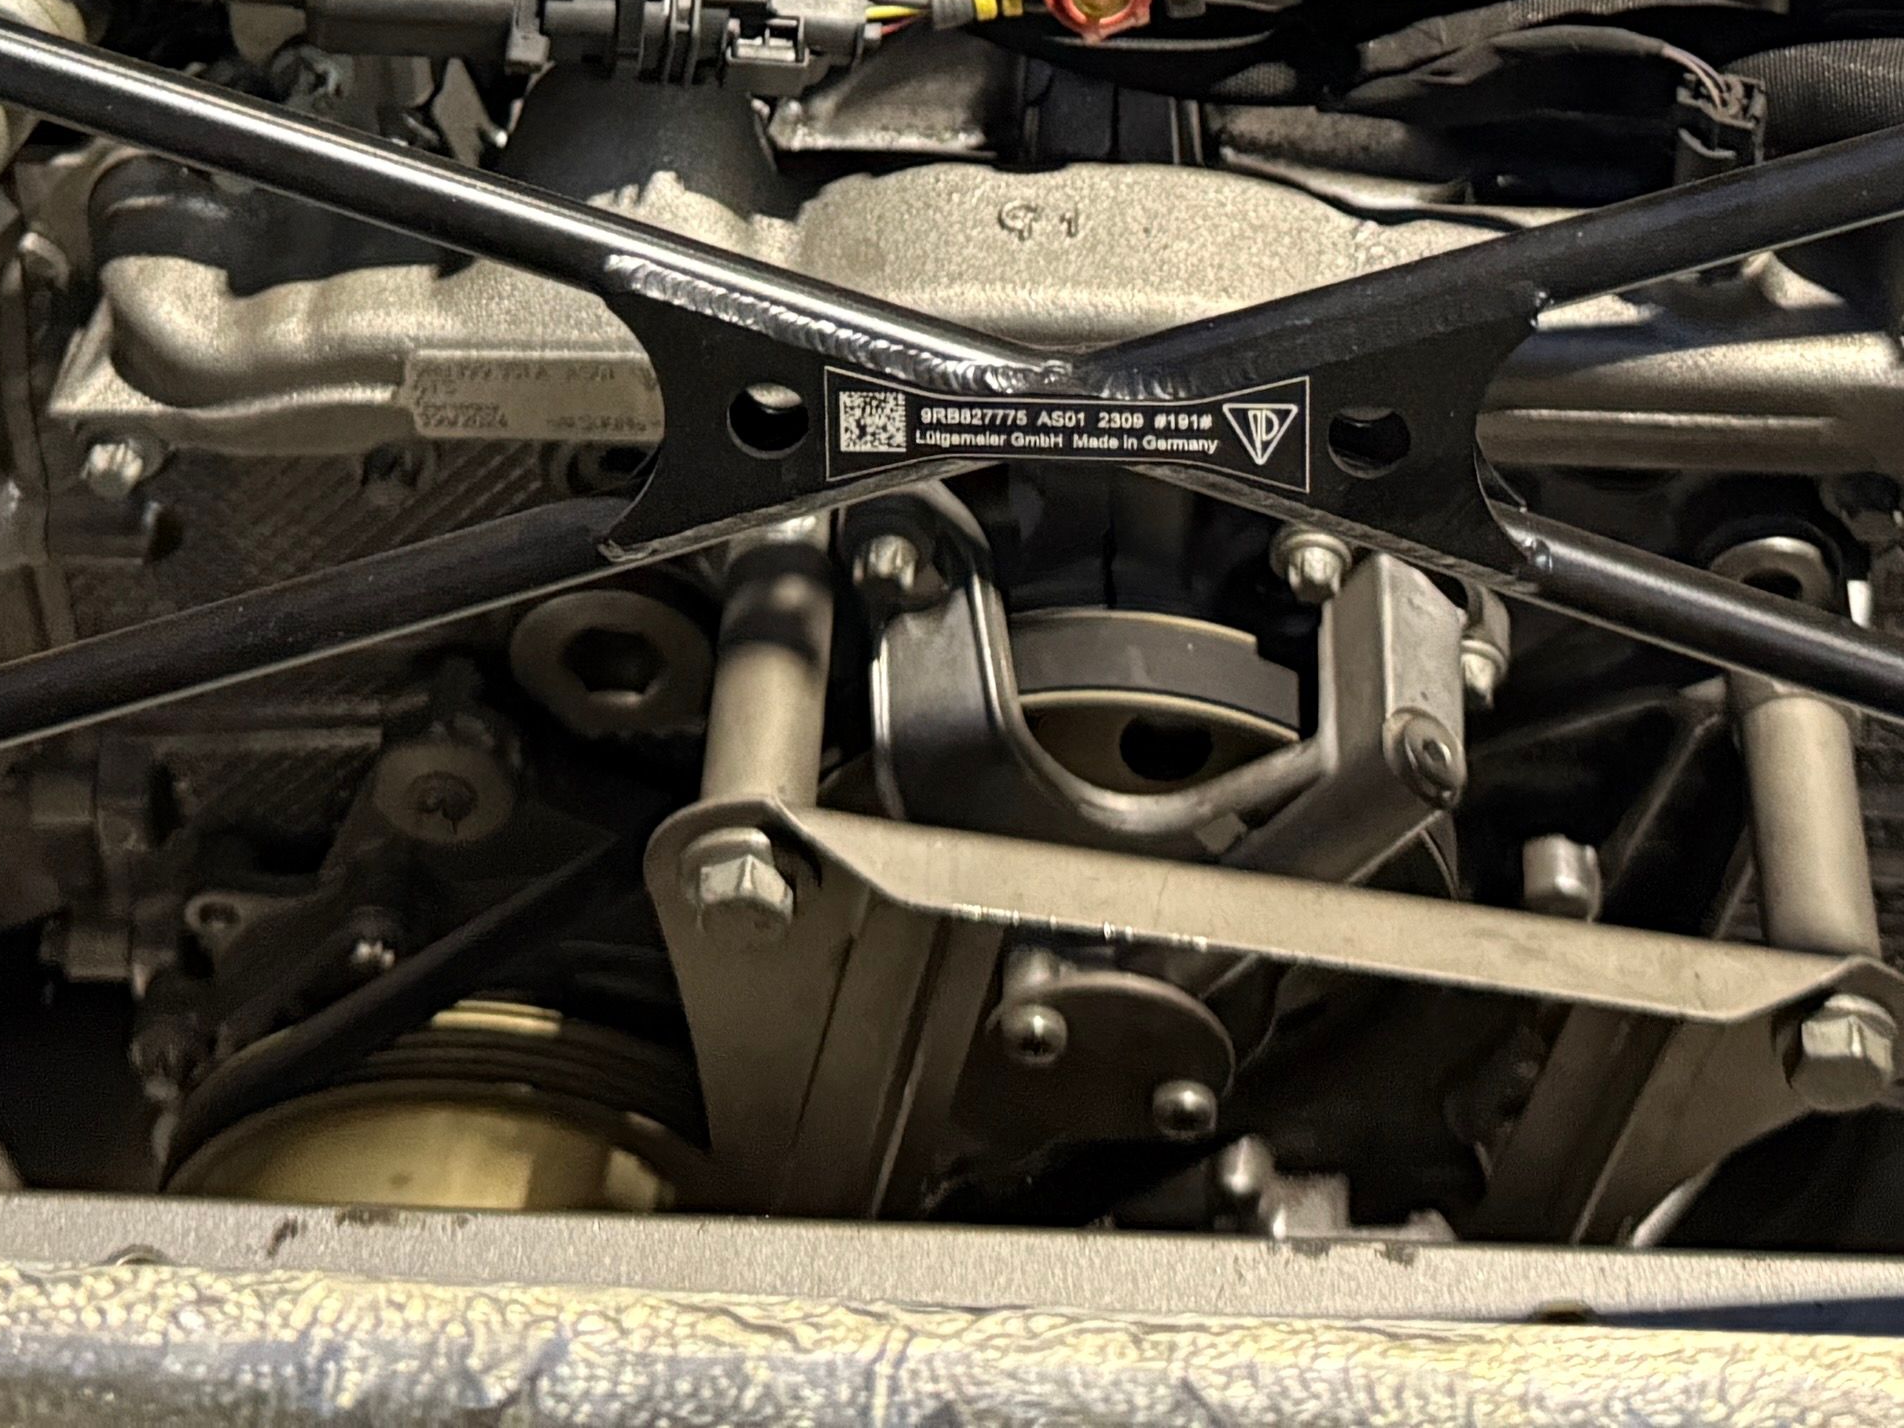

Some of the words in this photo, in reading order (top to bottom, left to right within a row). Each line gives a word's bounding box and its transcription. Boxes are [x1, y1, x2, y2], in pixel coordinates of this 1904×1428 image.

[1037, 410, 1085, 427] AS01
[1011, 431, 1063, 448] GmbH
[1073, 434, 1118, 450] Made
[1123, 434, 1138, 451] in
[1142, 434, 1218, 454] Germany
